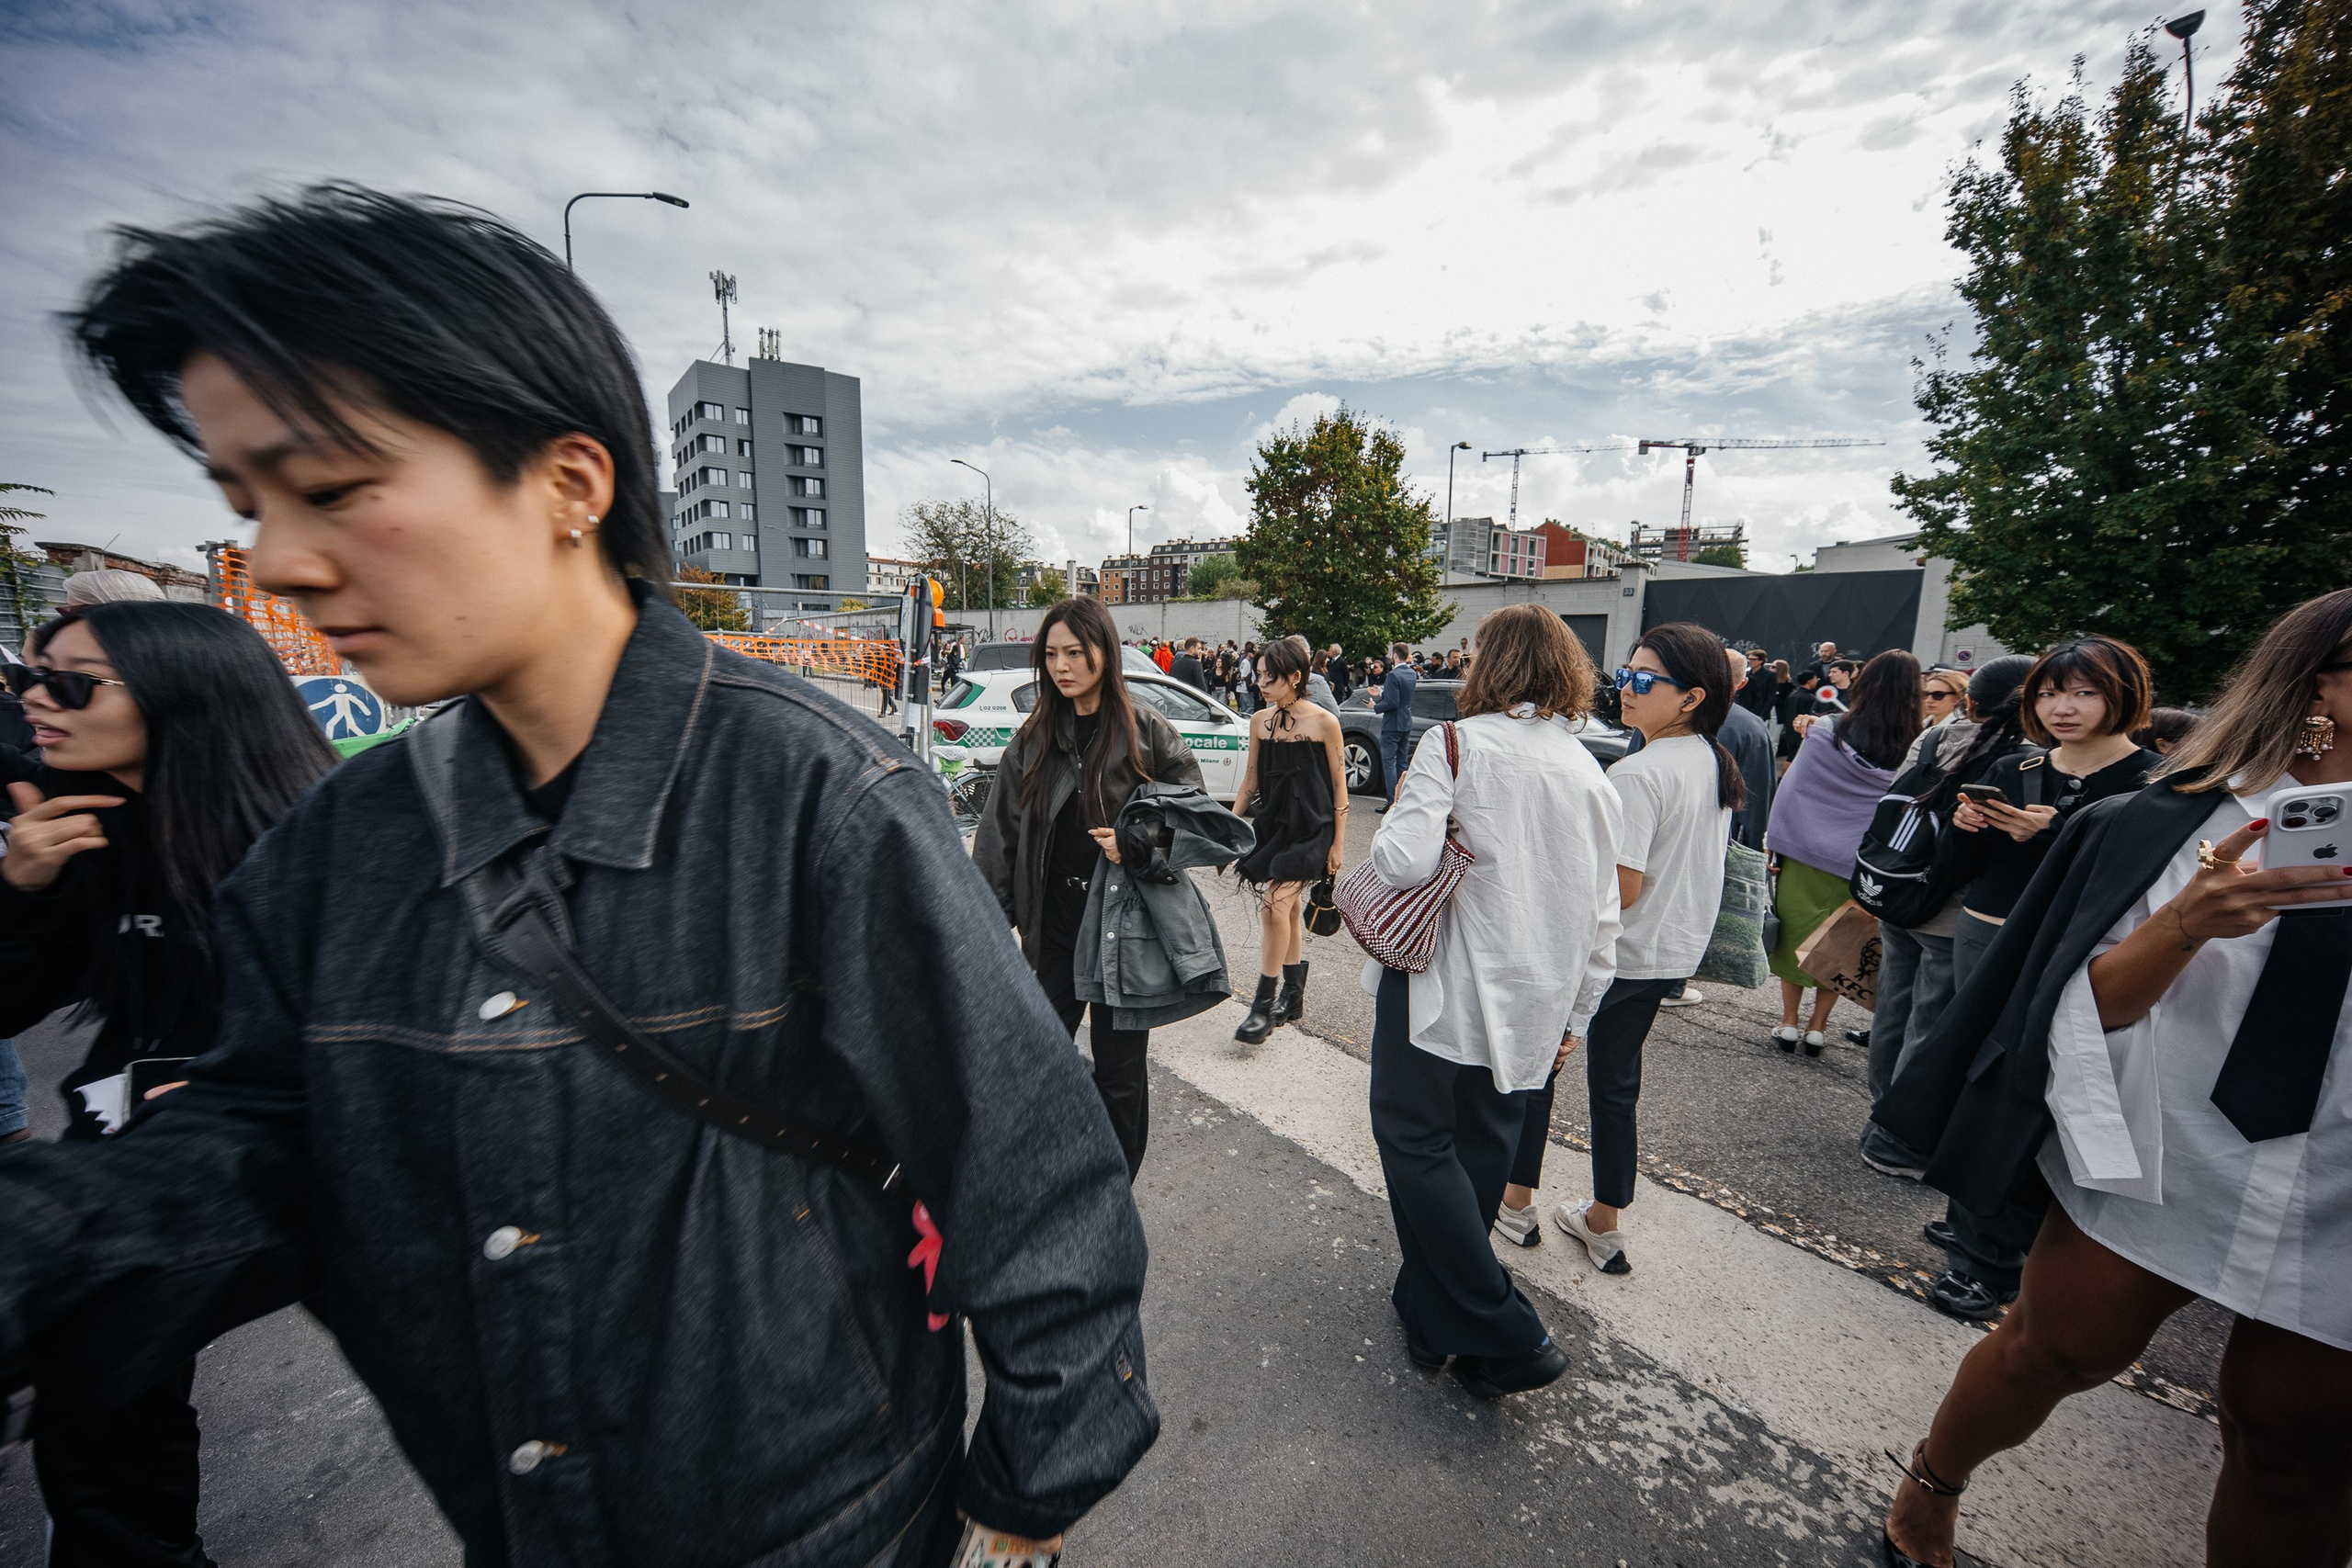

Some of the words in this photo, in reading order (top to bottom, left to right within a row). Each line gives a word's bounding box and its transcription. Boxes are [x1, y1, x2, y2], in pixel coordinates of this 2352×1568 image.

[1183, 736, 1228, 749] ocale
[1857, 890, 1883, 907] adidas
[1830, 973, 1874, 1000] KFC
